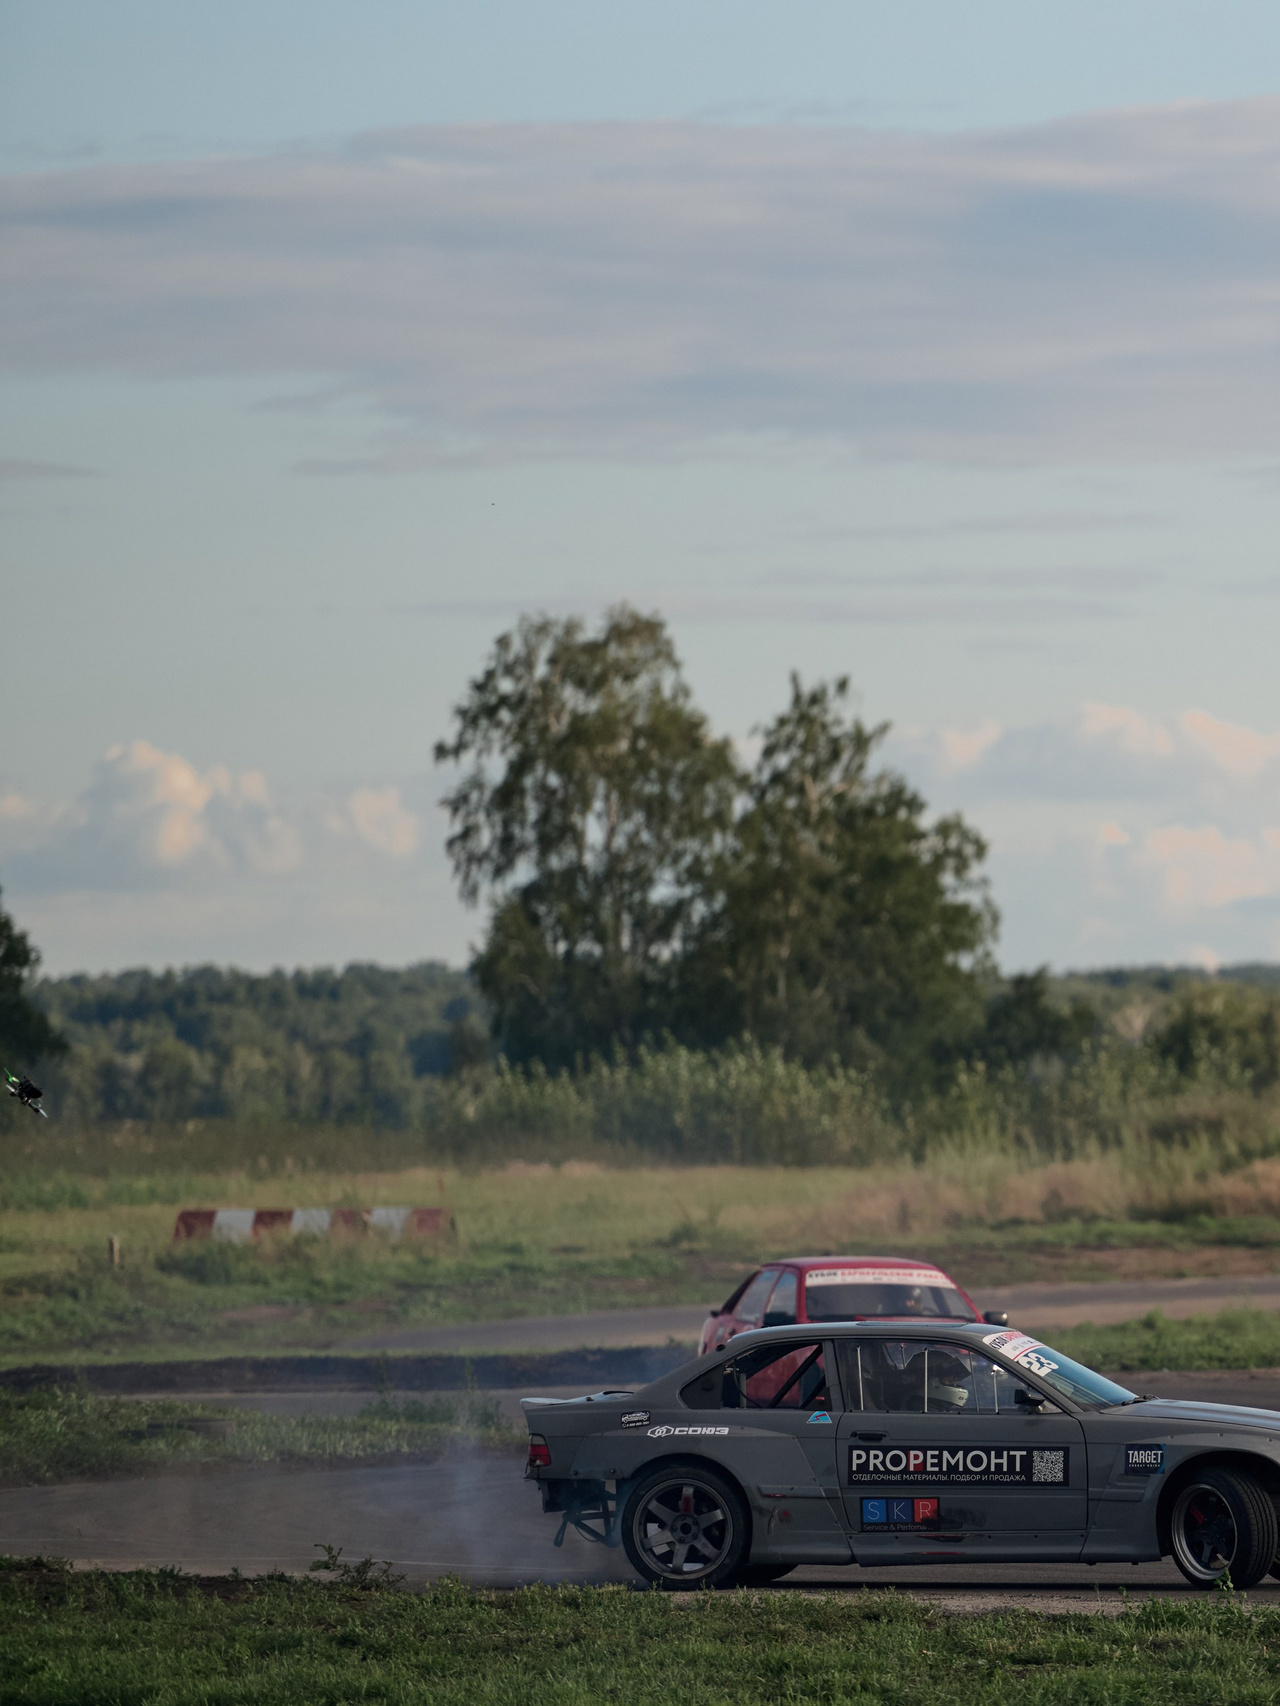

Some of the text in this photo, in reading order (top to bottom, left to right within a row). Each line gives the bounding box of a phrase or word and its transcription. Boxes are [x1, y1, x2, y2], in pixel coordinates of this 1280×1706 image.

[1018, 1352, 1059, 1377] 23
[1128, 1451, 1163, 1463] TARGET
[868, 1502, 932, 1520] SKR
